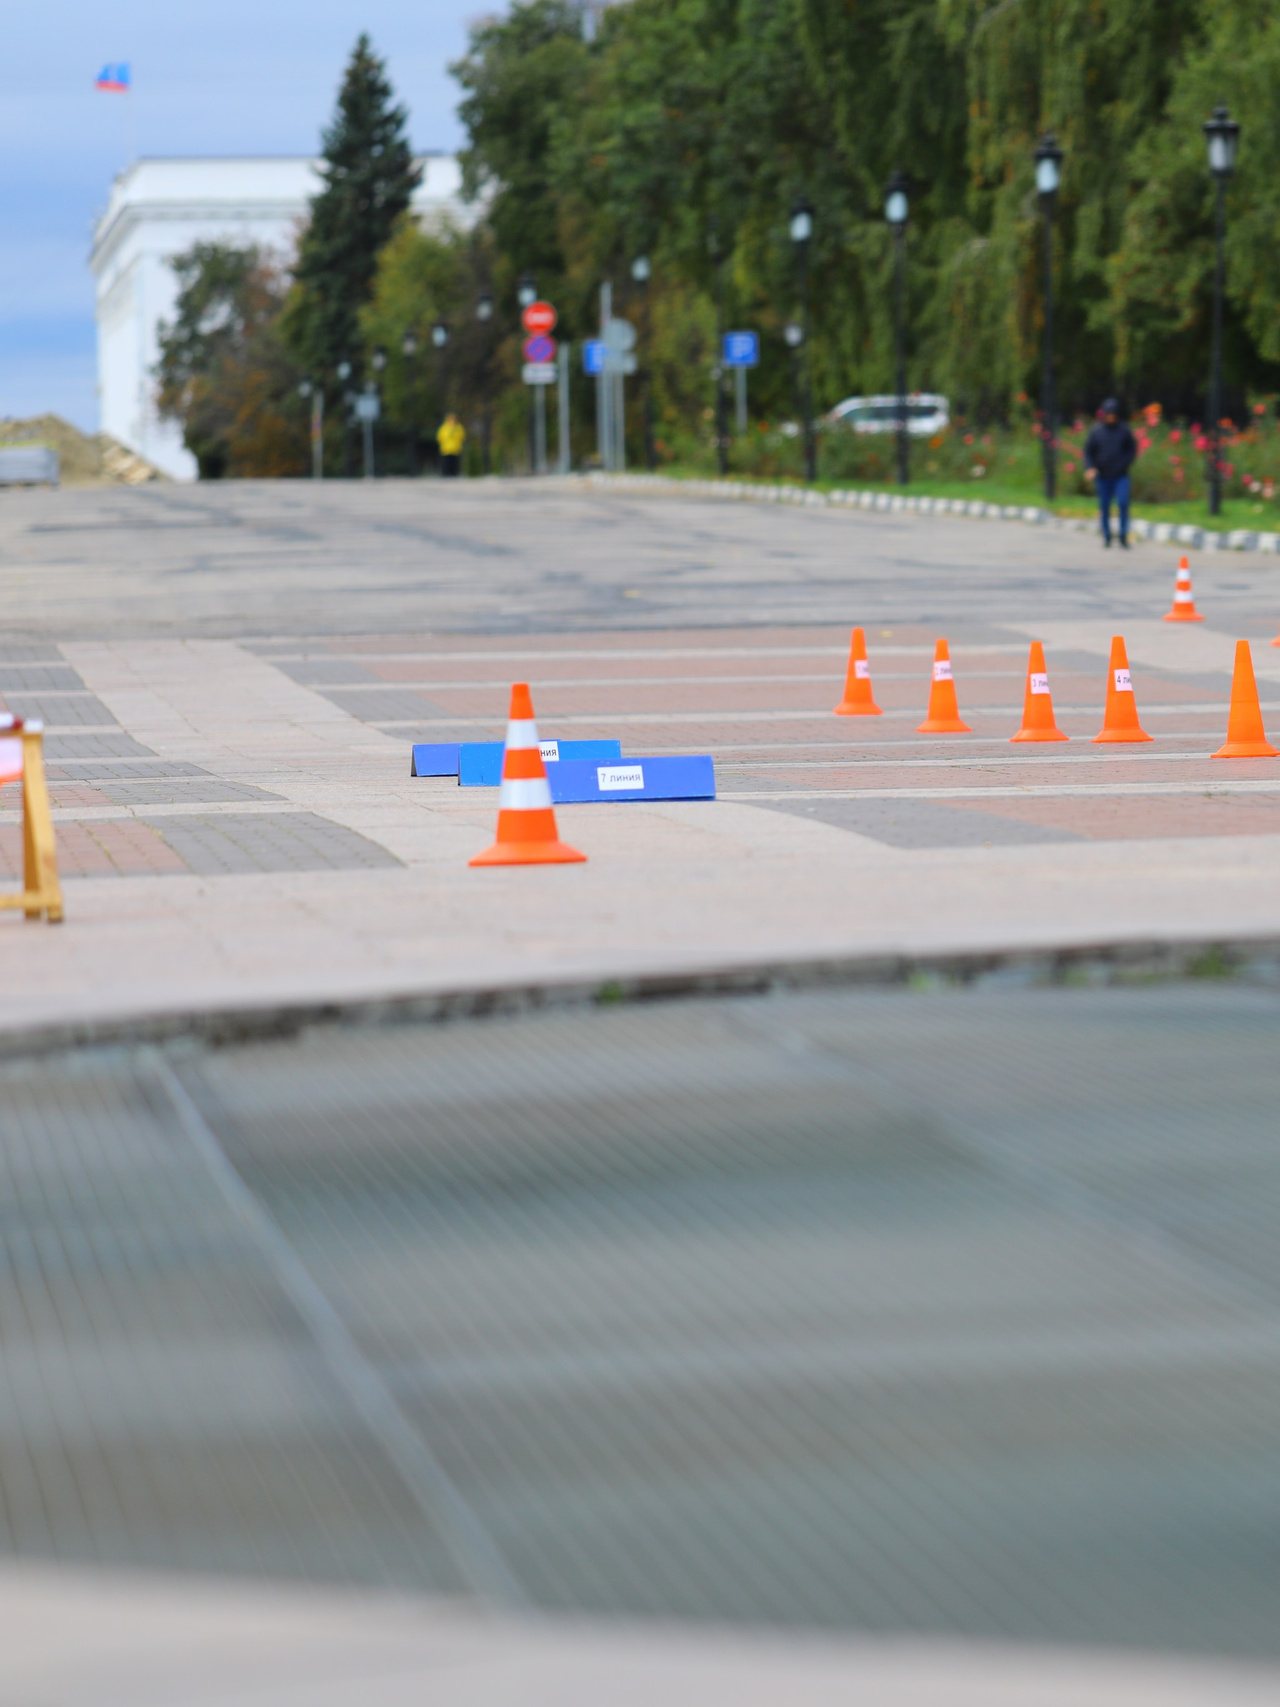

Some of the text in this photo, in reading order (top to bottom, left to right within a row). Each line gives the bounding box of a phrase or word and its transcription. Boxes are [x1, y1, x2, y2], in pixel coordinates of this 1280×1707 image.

[1117, 675, 1122, 684] 4
[601, 773, 642, 783] 7 линия
